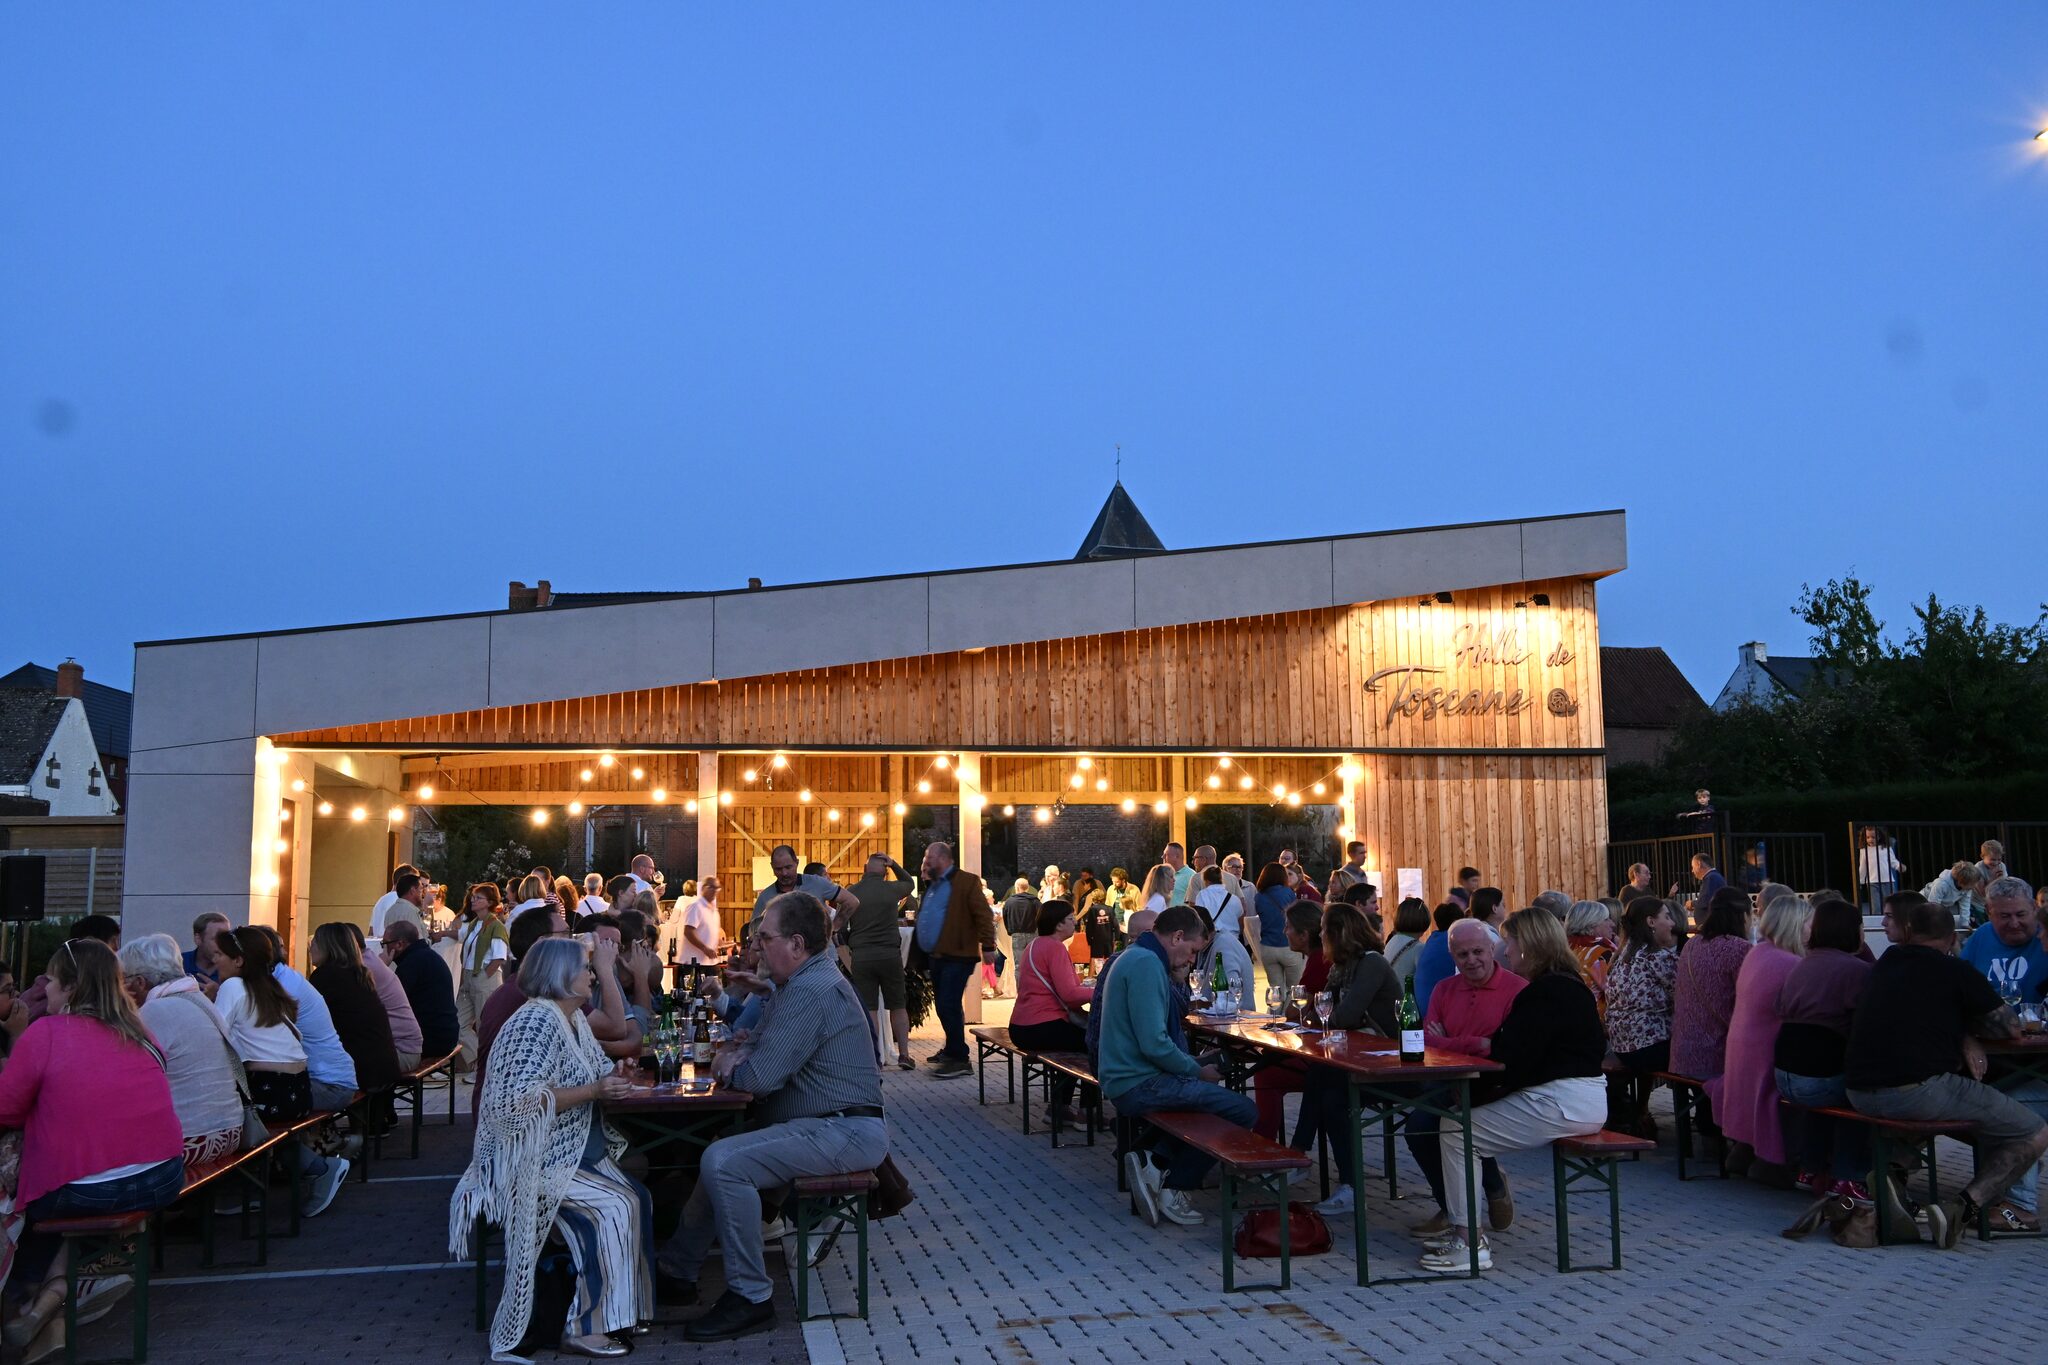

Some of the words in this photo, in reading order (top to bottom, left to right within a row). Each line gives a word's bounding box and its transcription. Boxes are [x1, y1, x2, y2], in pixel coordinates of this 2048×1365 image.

[1452, 623, 1533, 668] Halle
[1546, 641, 1575, 667] de
[1363, 665, 1534, 729] Toscane
[1987, 956, 2029, 982] NO
